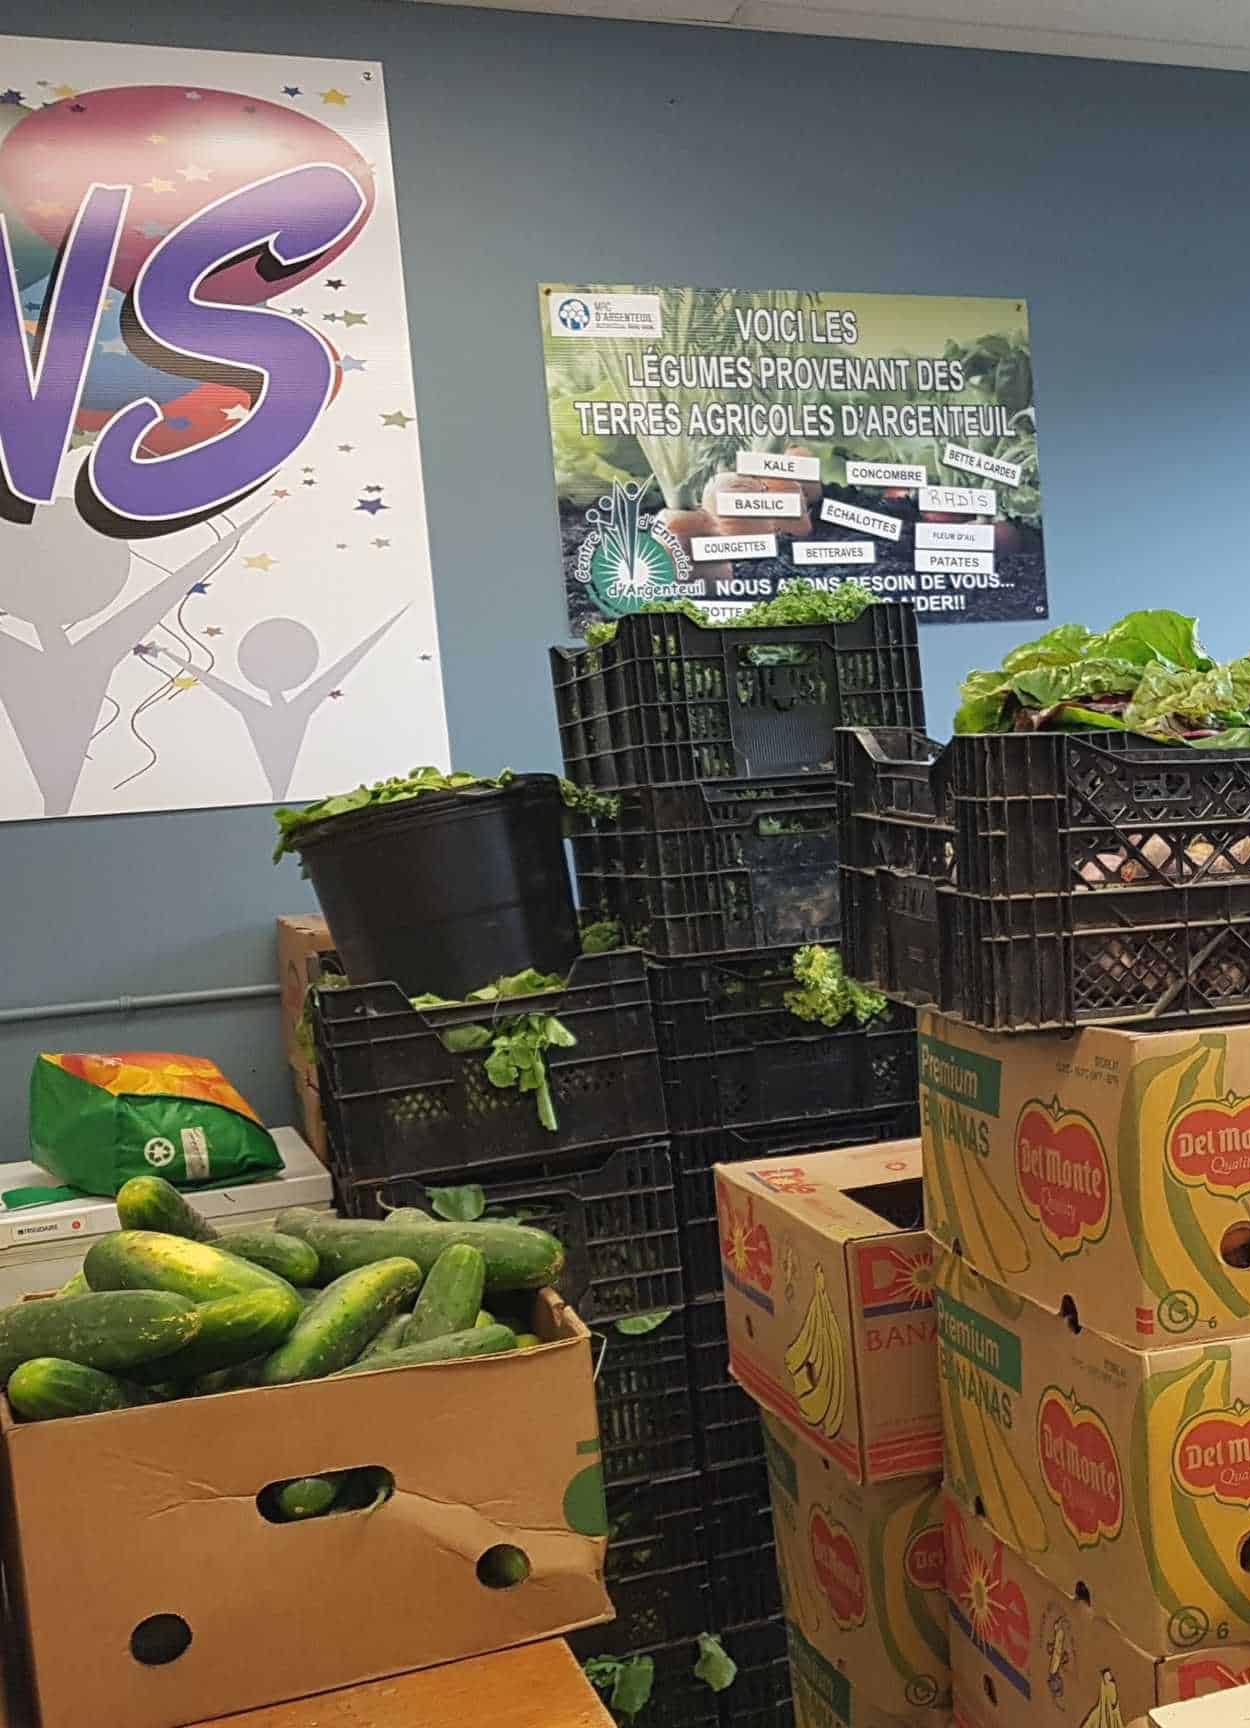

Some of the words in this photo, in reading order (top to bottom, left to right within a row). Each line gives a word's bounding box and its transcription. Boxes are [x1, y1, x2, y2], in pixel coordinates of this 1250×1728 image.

[735, 308, 804, 343] VOICI
[810, 311, 858, 343] LES
[626, 348, 753, 388] LÉGUMES
[759, 356, 910, 390] PROVENANT
[917, 359, 965, 391] DES
[574, 401, 682, 435] TERRES
[688, 402, 835, 437] AGRICOLES
[841, 404, 1016, 437] D'ARGENTEUIL
[763, 459, 795, 473] KALE
[851, 468, 922, 482] CONCOMBRE
[949, 450, 975, 467] BETTE
[984, 462, 1017, 480] CARDES
[735, 499, 784, 510] BASILIC
[574, 531, 601, 583] Centre
[704, 541, 766, 554] COURGETTES
[805, 548, 864, 558] BETTERAVES
[930, 556, 980, 568] PATATES
[607, 579, 705, 600] d'Argenteuil
[716, 578, 772, 596] NOUS
[921, 574, 946, 591] DE
[950, 573, 1015, 589] VOUS...
[921, 1043, 978, 1099] Premium
[1178, 1129, 1216, 1158] Del
[1020, 1138, 1044, 1179] Del
[1044, 1146, 1101, 1199] Monte
[936, 1296, 1000, 1369] Premium
[1042, 1422, 1065, 1469] Del
[1065, 1438, 1117, 1503] Monte
[1185, 1440, 1224, 1470] Del
[1216, 1622, 1229, 1640] 6
